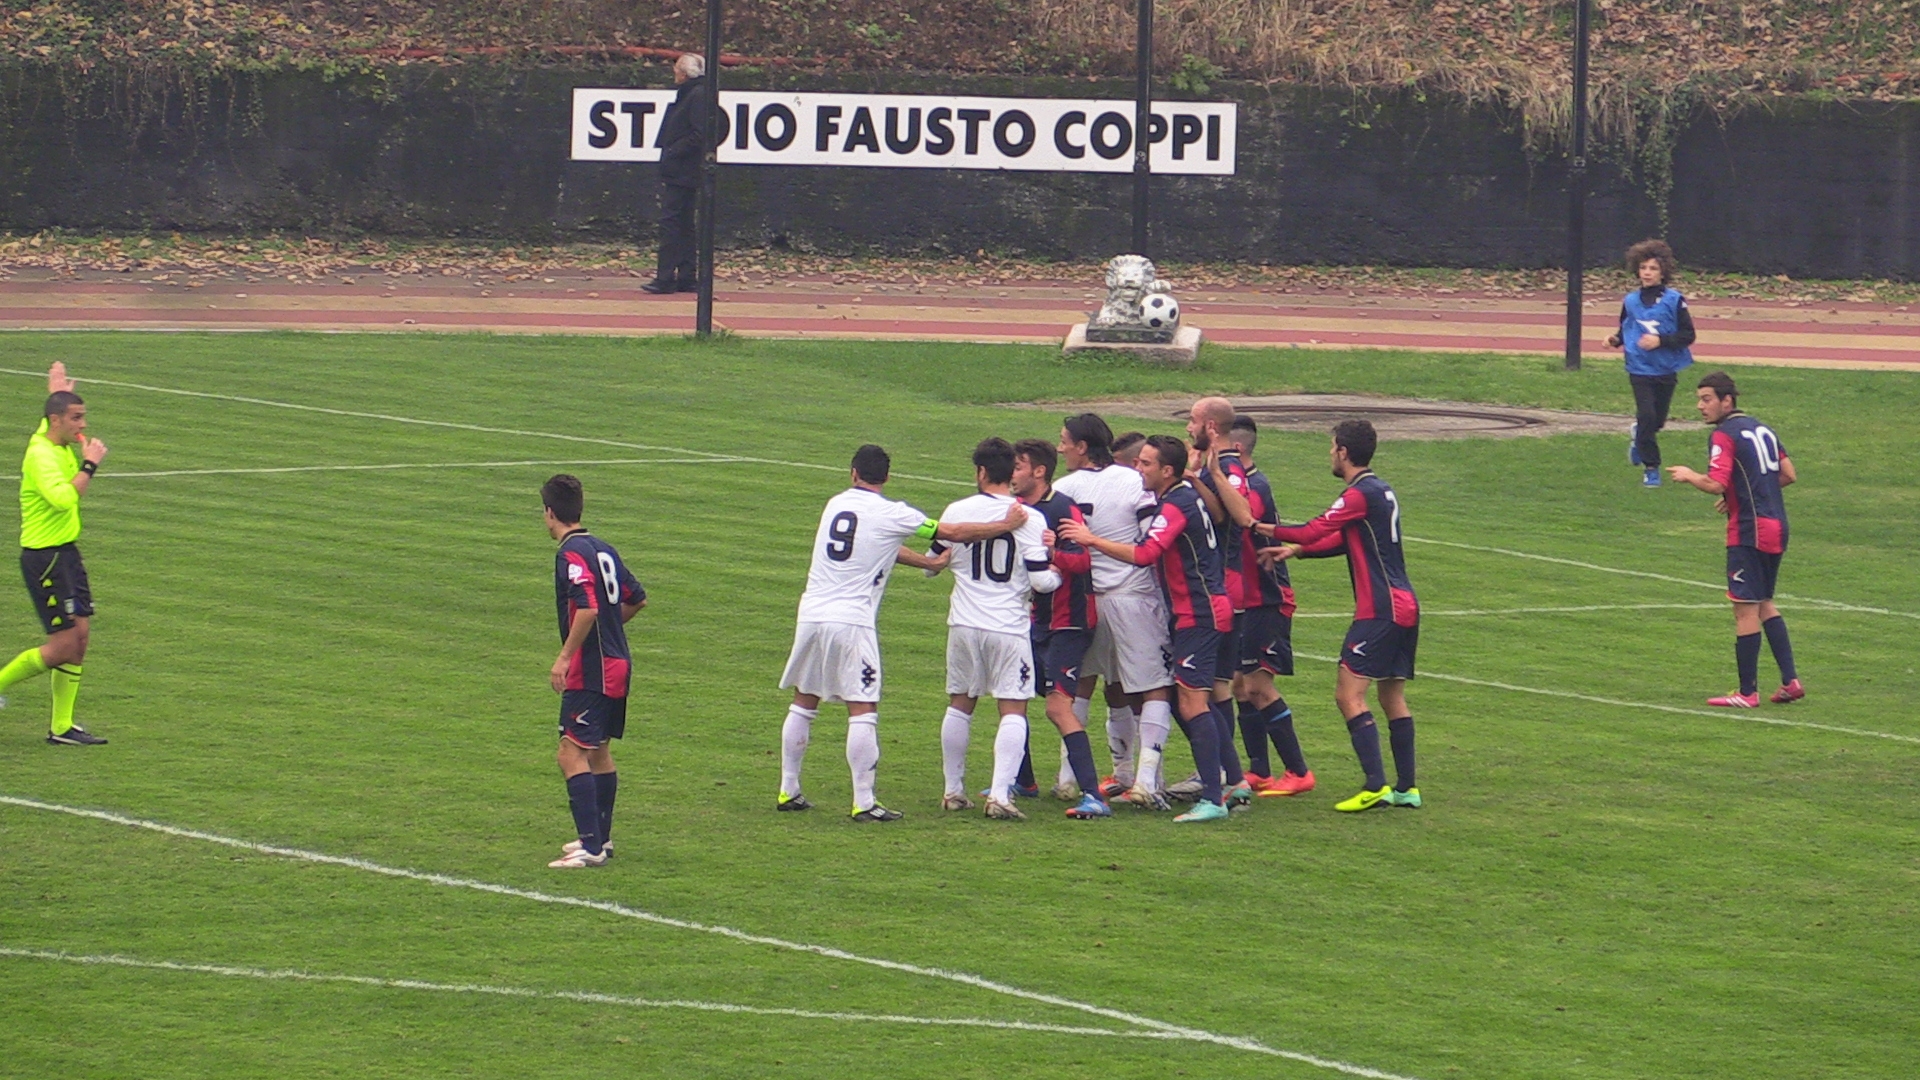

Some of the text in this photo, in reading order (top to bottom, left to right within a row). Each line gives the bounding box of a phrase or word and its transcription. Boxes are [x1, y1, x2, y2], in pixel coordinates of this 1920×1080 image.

[588, 100, 797, 151] STIO
[815, 105, 1036, 158] FAUSTO
[1741, 426, 1780, 474] 10
[826, 511, 858, 561] 9
[1196, 498, 1217, 549] 5
[597, 552, 620, 605] 8
[963, 531, 1017, 583] 10
